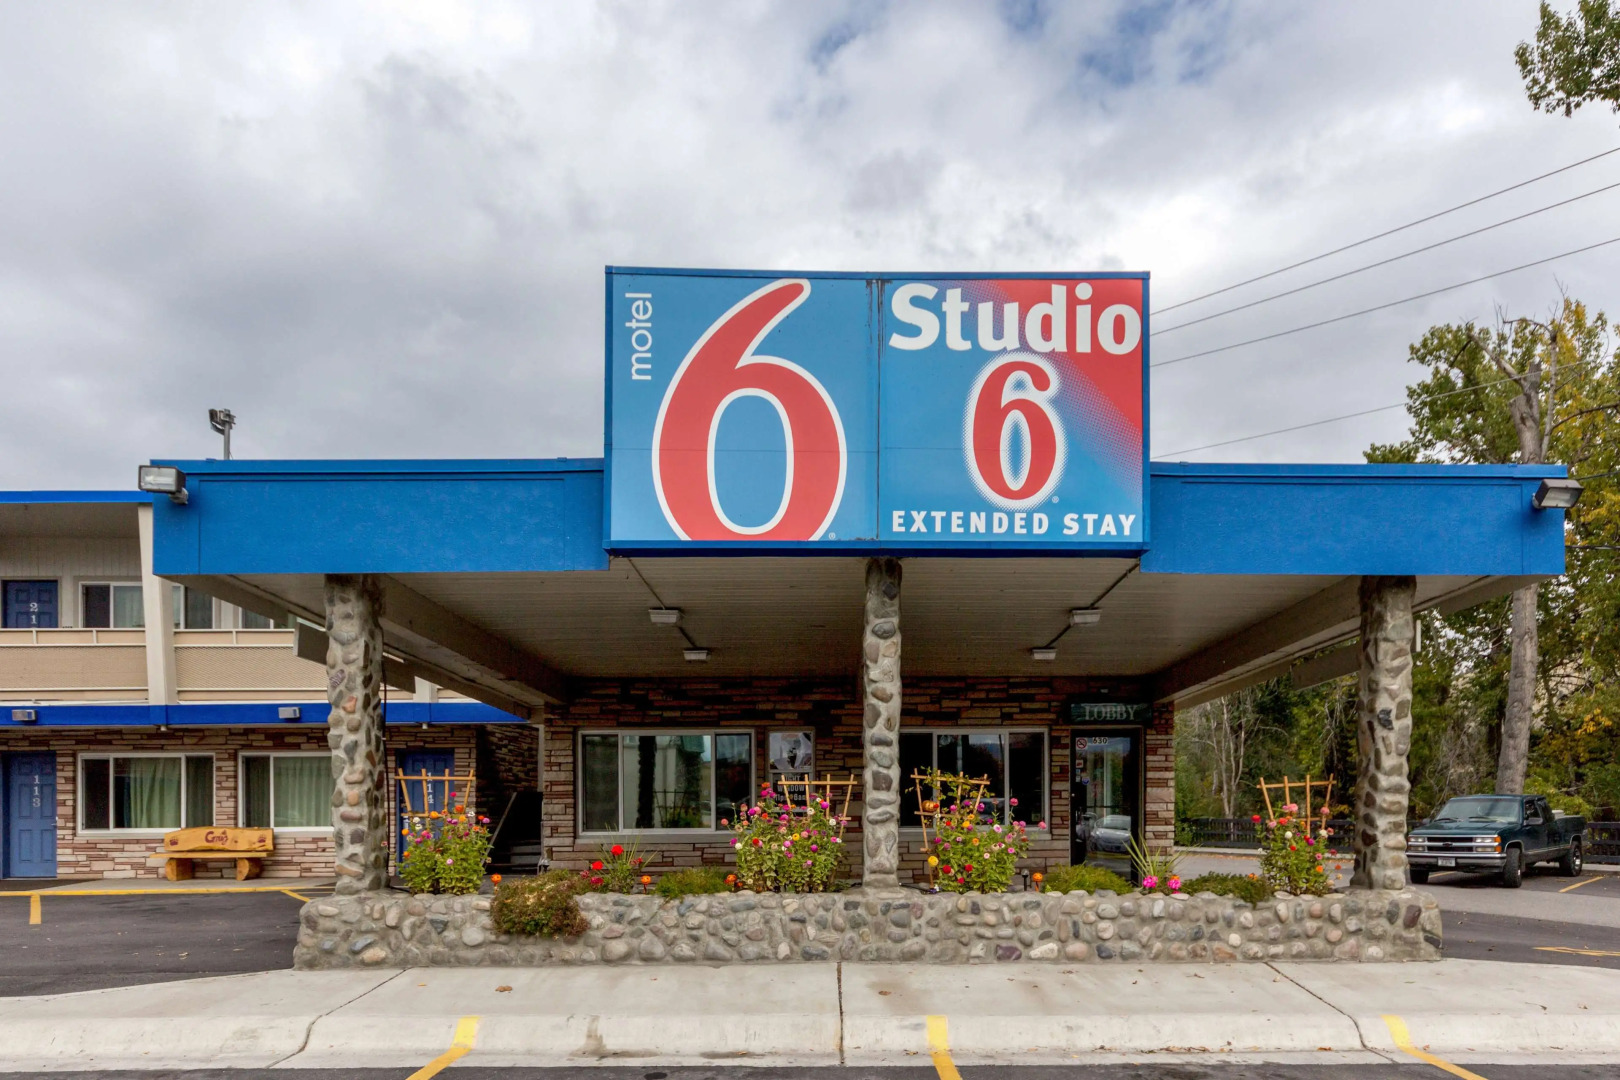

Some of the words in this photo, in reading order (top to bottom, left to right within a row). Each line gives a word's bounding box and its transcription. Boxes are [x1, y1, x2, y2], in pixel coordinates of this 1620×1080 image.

[625, 292, 652, 381] motel
[889, 282, 1142, 355] Studio
[652, 278, 848, 541] 6
[968, 355, 1062, 505] 6
[892, 510, 1049, 535] EXTENDED
[1062, 512, 1136, 536] STAY
[29, 602, 39, 627] 21
[1085, 705, 1138, 720] LOBBY
[32, 774, 41, 807] 113
